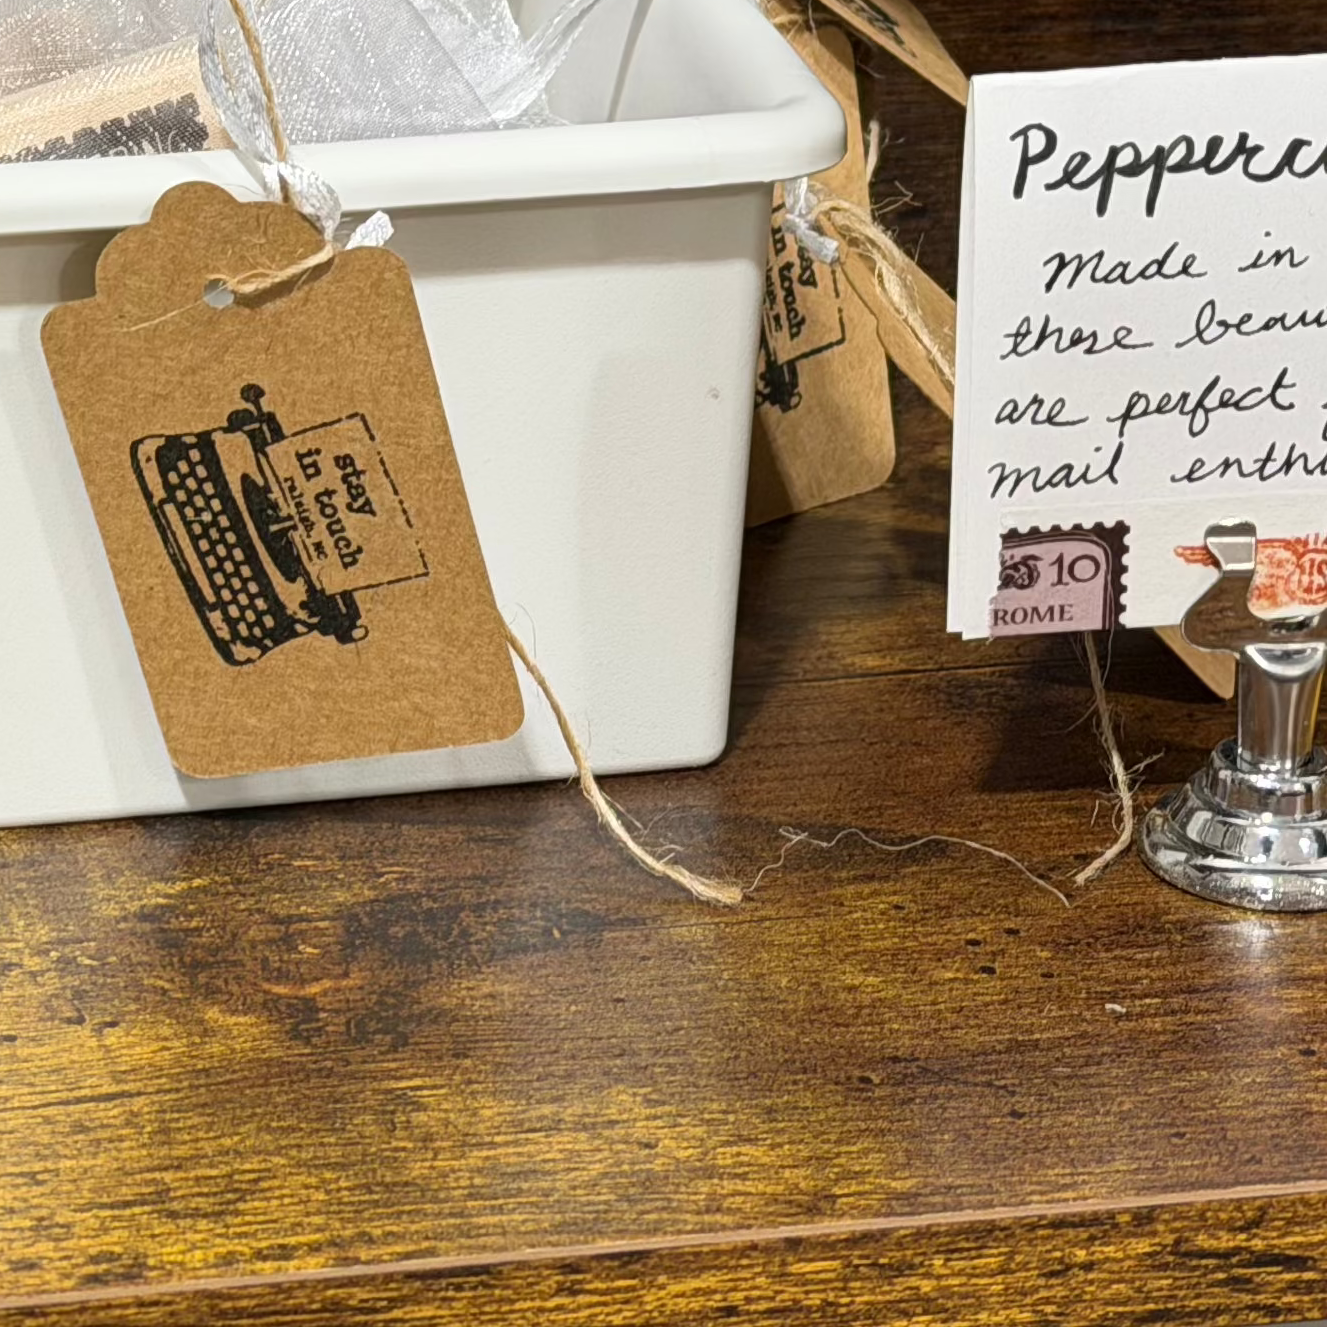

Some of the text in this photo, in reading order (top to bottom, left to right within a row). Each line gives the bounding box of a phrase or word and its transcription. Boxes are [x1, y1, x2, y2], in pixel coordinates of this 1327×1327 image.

[1011, 123, 1327, 217] Pepperc
[1238, 231, 1308, 273] in
[1176, 299, 1327, 348] beau
[995, 394, 1088, 427] are
[1107, 367, 1296, 437] perfect
[334, 453, 377, 517] stay
[989, 442, 1124, 498] mail
[295, 446, 363, 570] in touch
[993, 604, 1075, 627] ROME
